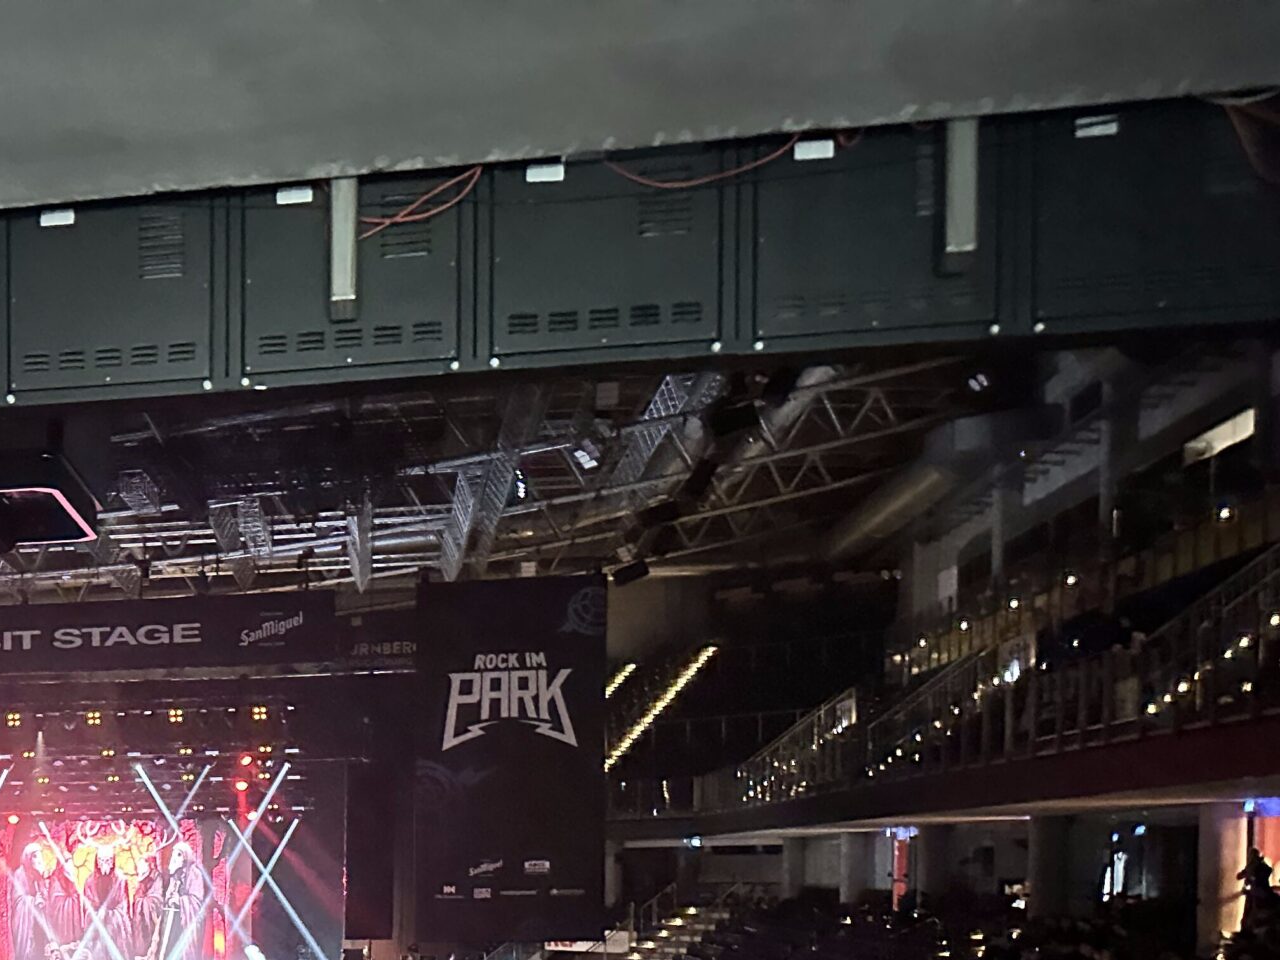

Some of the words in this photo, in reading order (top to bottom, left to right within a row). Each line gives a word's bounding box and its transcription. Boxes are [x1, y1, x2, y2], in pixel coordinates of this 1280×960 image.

[52, 622, 202, 650] STAGE
[474, 652, 520, 670] ROCK
[526, 651, 548, 668] IM
[441, 668, 579, 752] PARK
